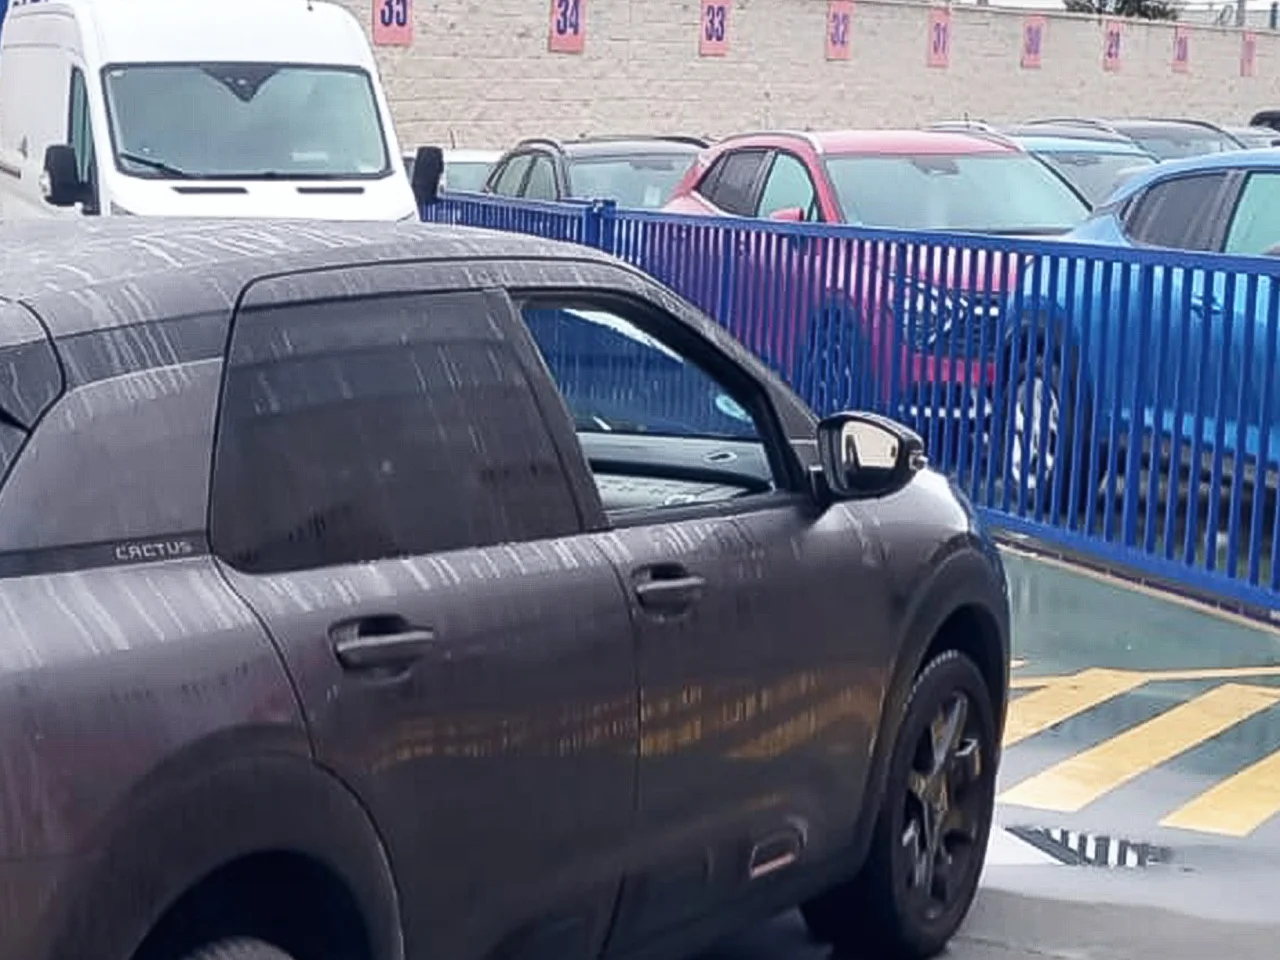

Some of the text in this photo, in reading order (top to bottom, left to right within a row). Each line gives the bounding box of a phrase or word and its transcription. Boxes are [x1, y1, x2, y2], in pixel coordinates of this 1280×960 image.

[556, 0, 580, 35] 34
[705, 5, 725, 42] 33
[830, 13, 849, 46] 32
[933, 23, 948, 54] 31
[115, 541, 192, 560] CACTUS
